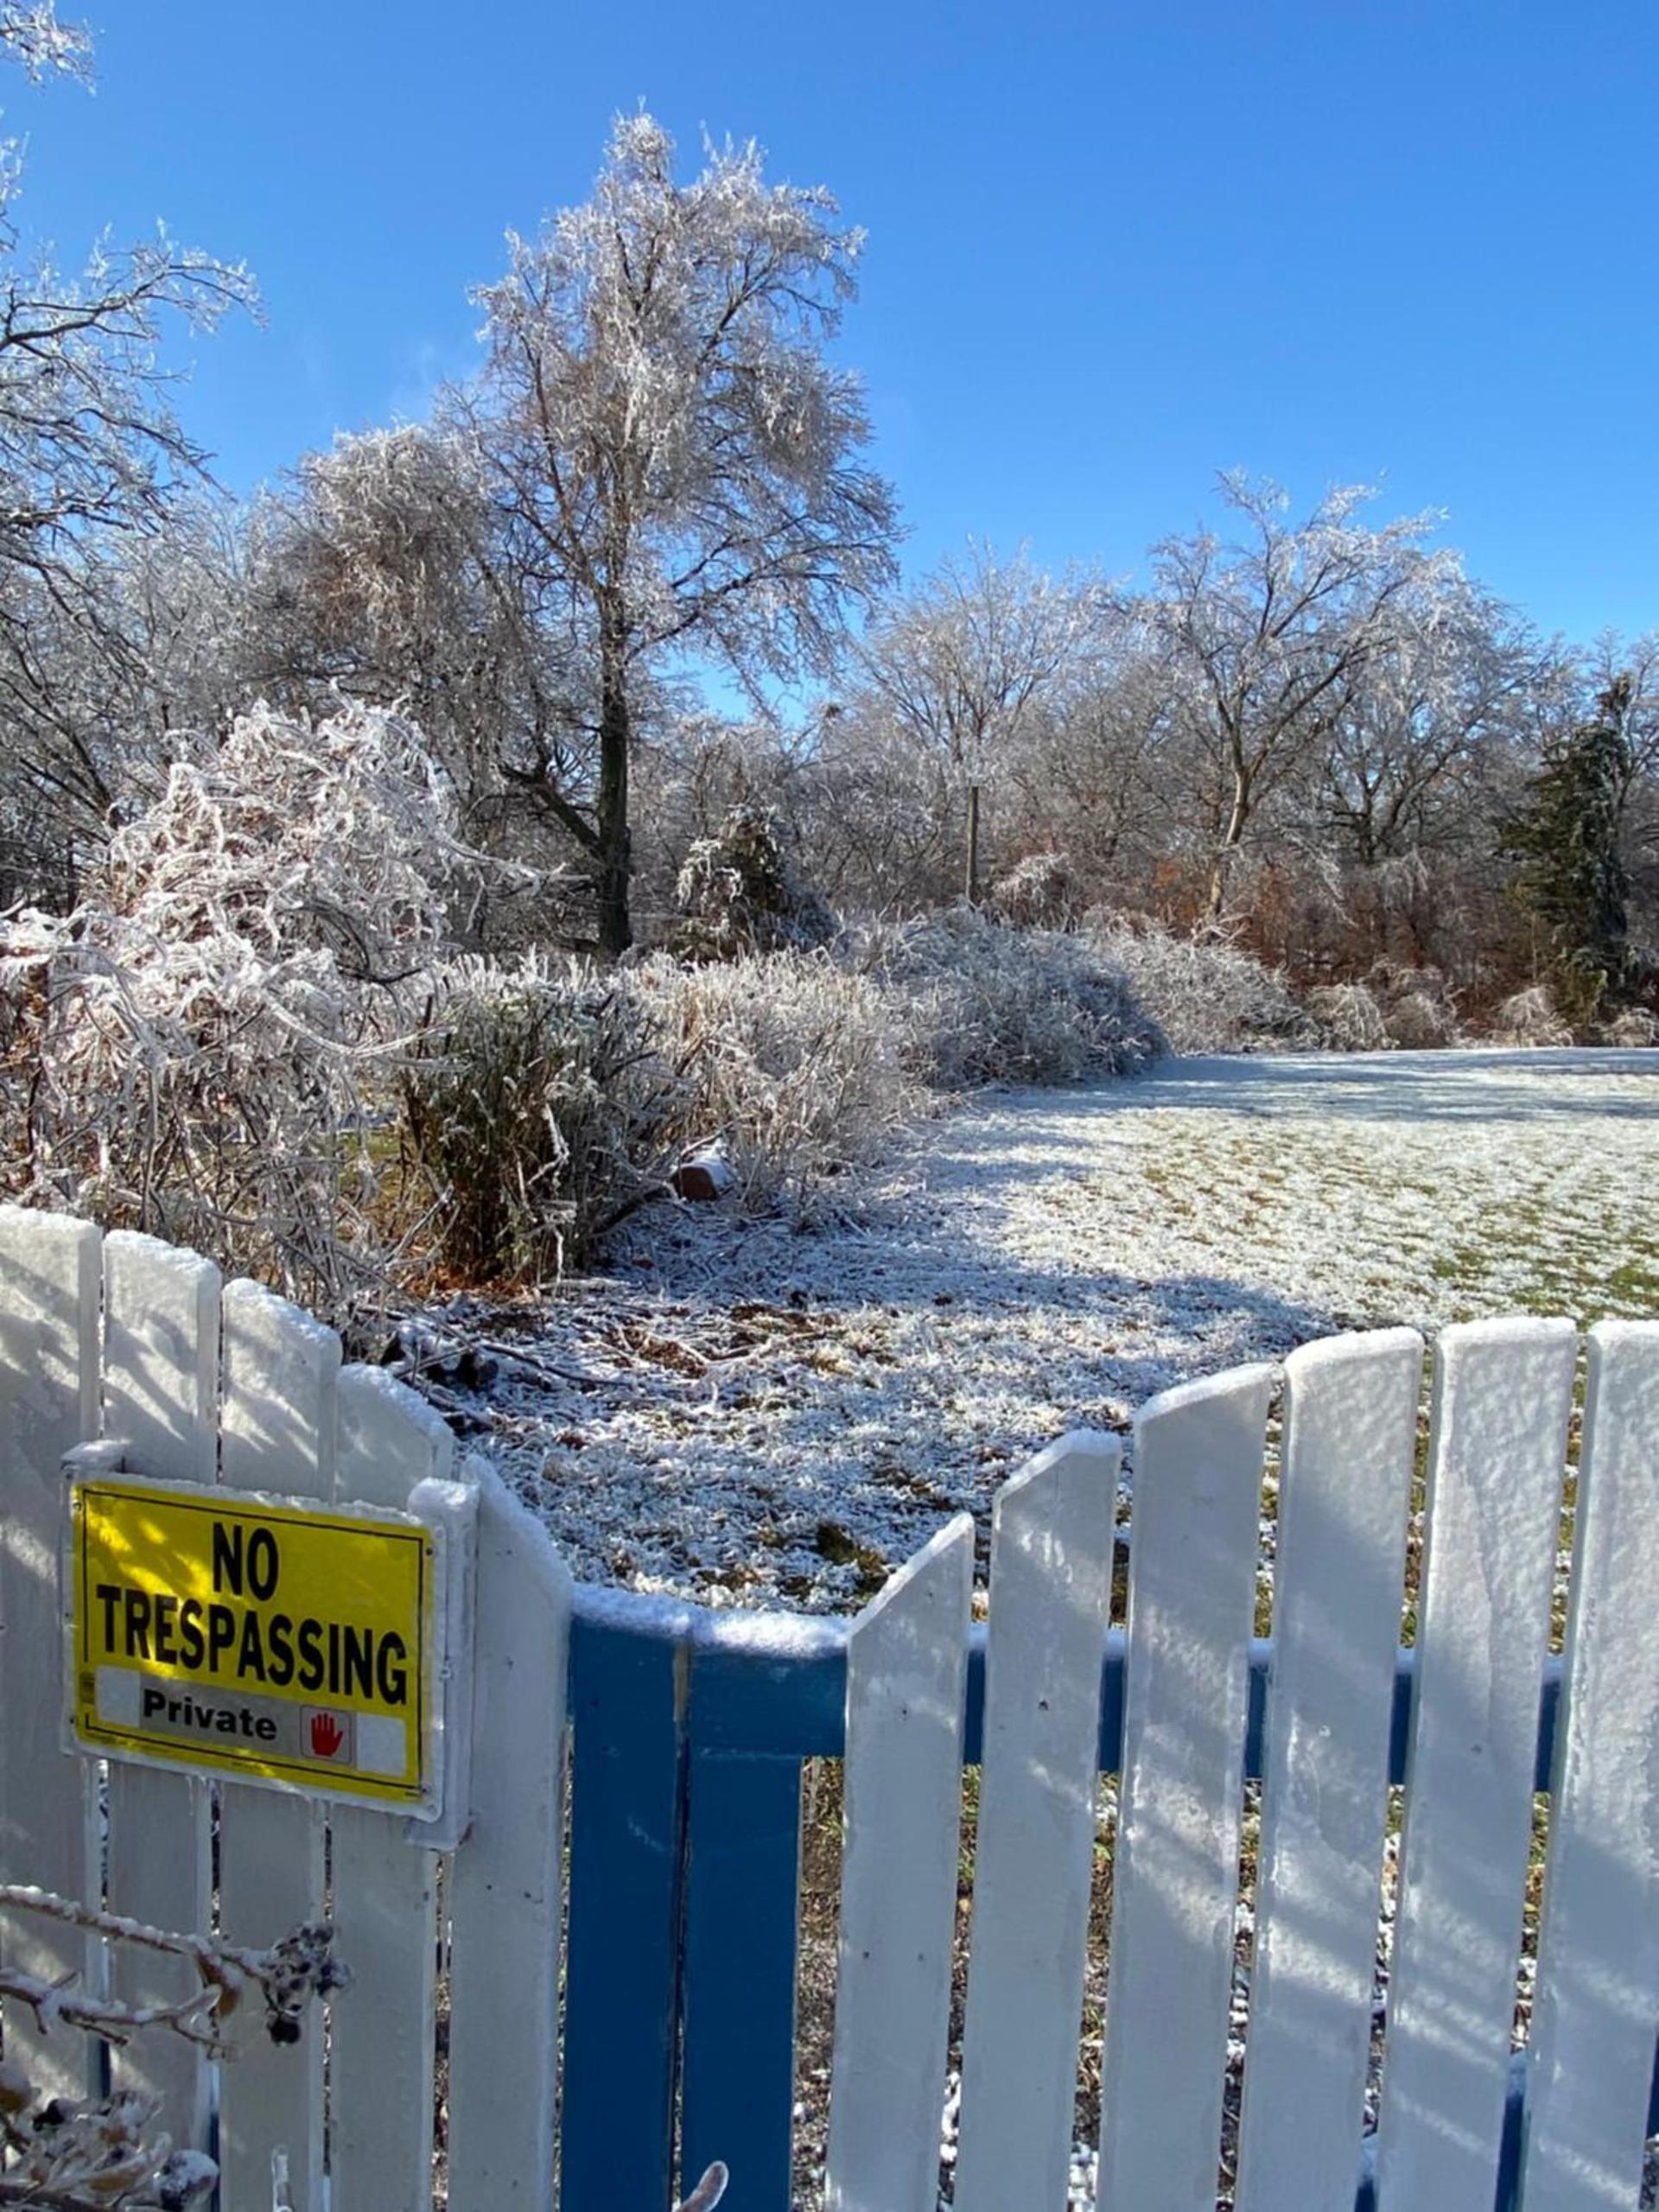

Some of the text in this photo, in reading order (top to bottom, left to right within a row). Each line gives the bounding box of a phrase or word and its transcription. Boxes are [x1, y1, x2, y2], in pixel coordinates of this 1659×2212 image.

[213, 1522, 278, 1601] NO
[96, 1585, 407, 1706] TRESPASSING
[143, 1689, 276, 1740] Private
